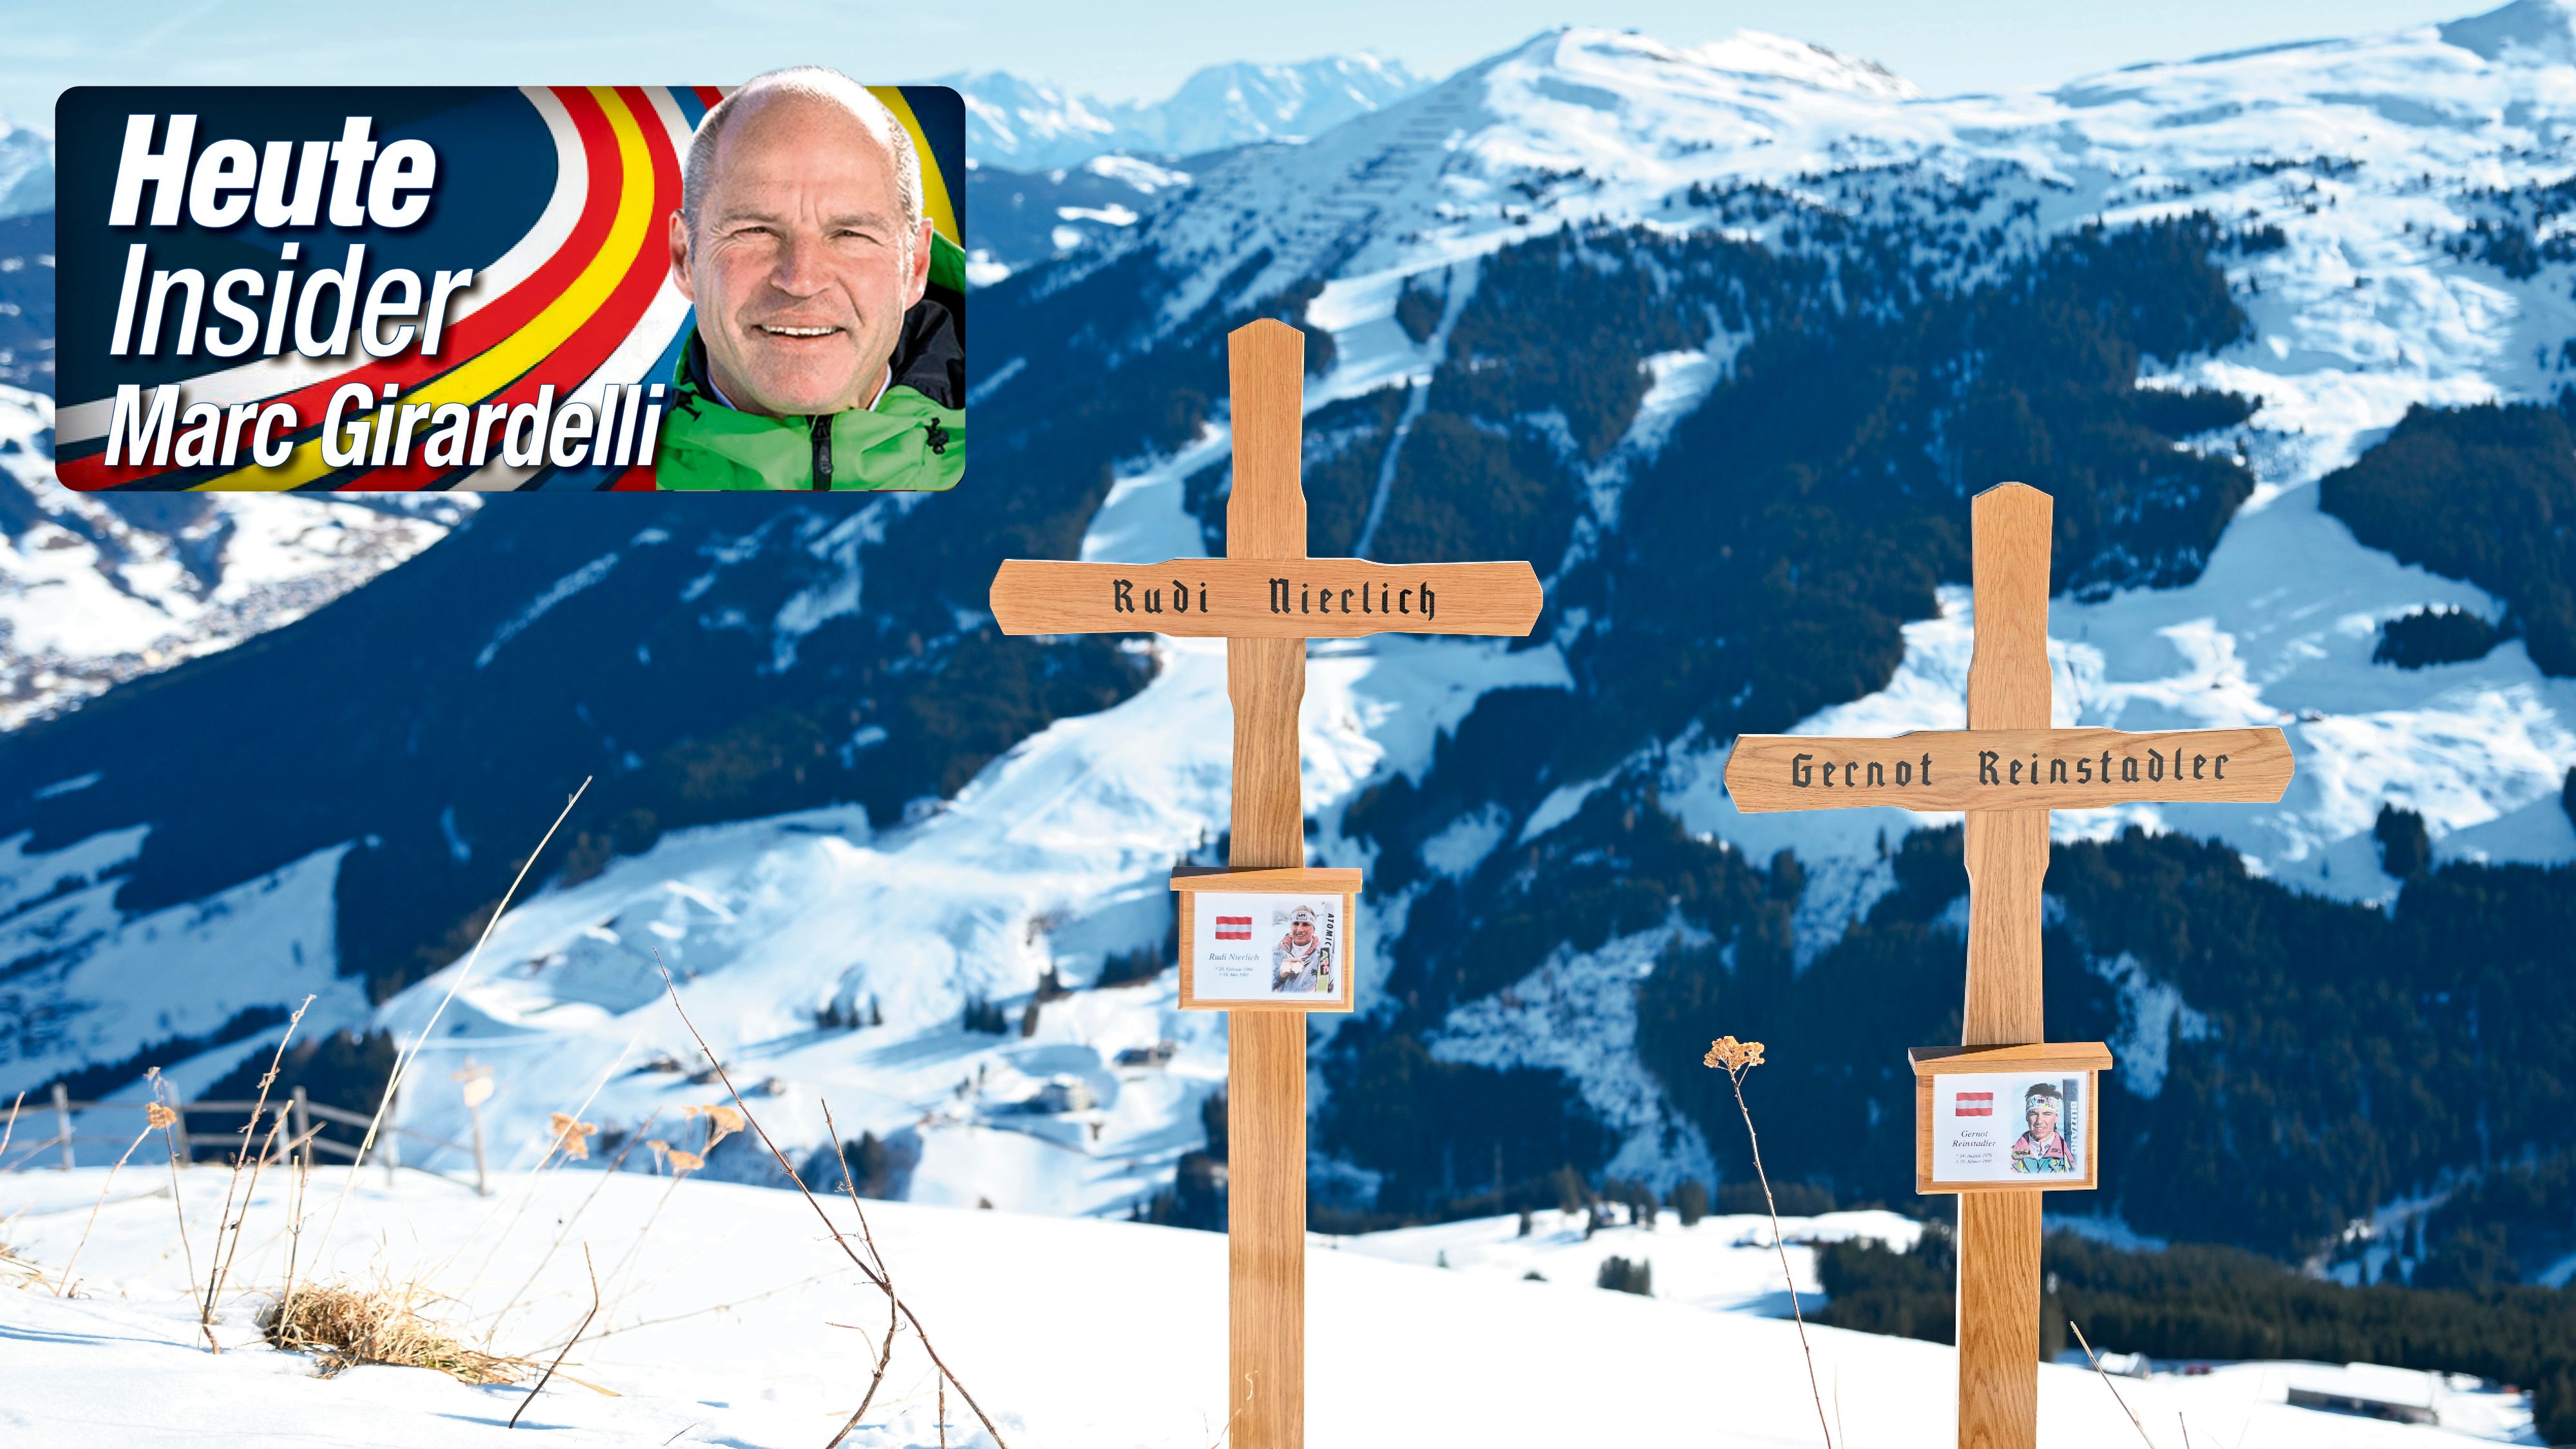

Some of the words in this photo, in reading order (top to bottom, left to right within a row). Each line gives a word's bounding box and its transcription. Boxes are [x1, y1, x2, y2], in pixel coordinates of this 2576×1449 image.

[1113, 579, 1209, 614] Rudi
[1269, 578, 1435, 621] Nierlich
[1792, 752, 1933, 788] Gernot
[1978, 747, 2230, 786] Reinstadler
[1324, 913, 1334, 947] ATOMIC
